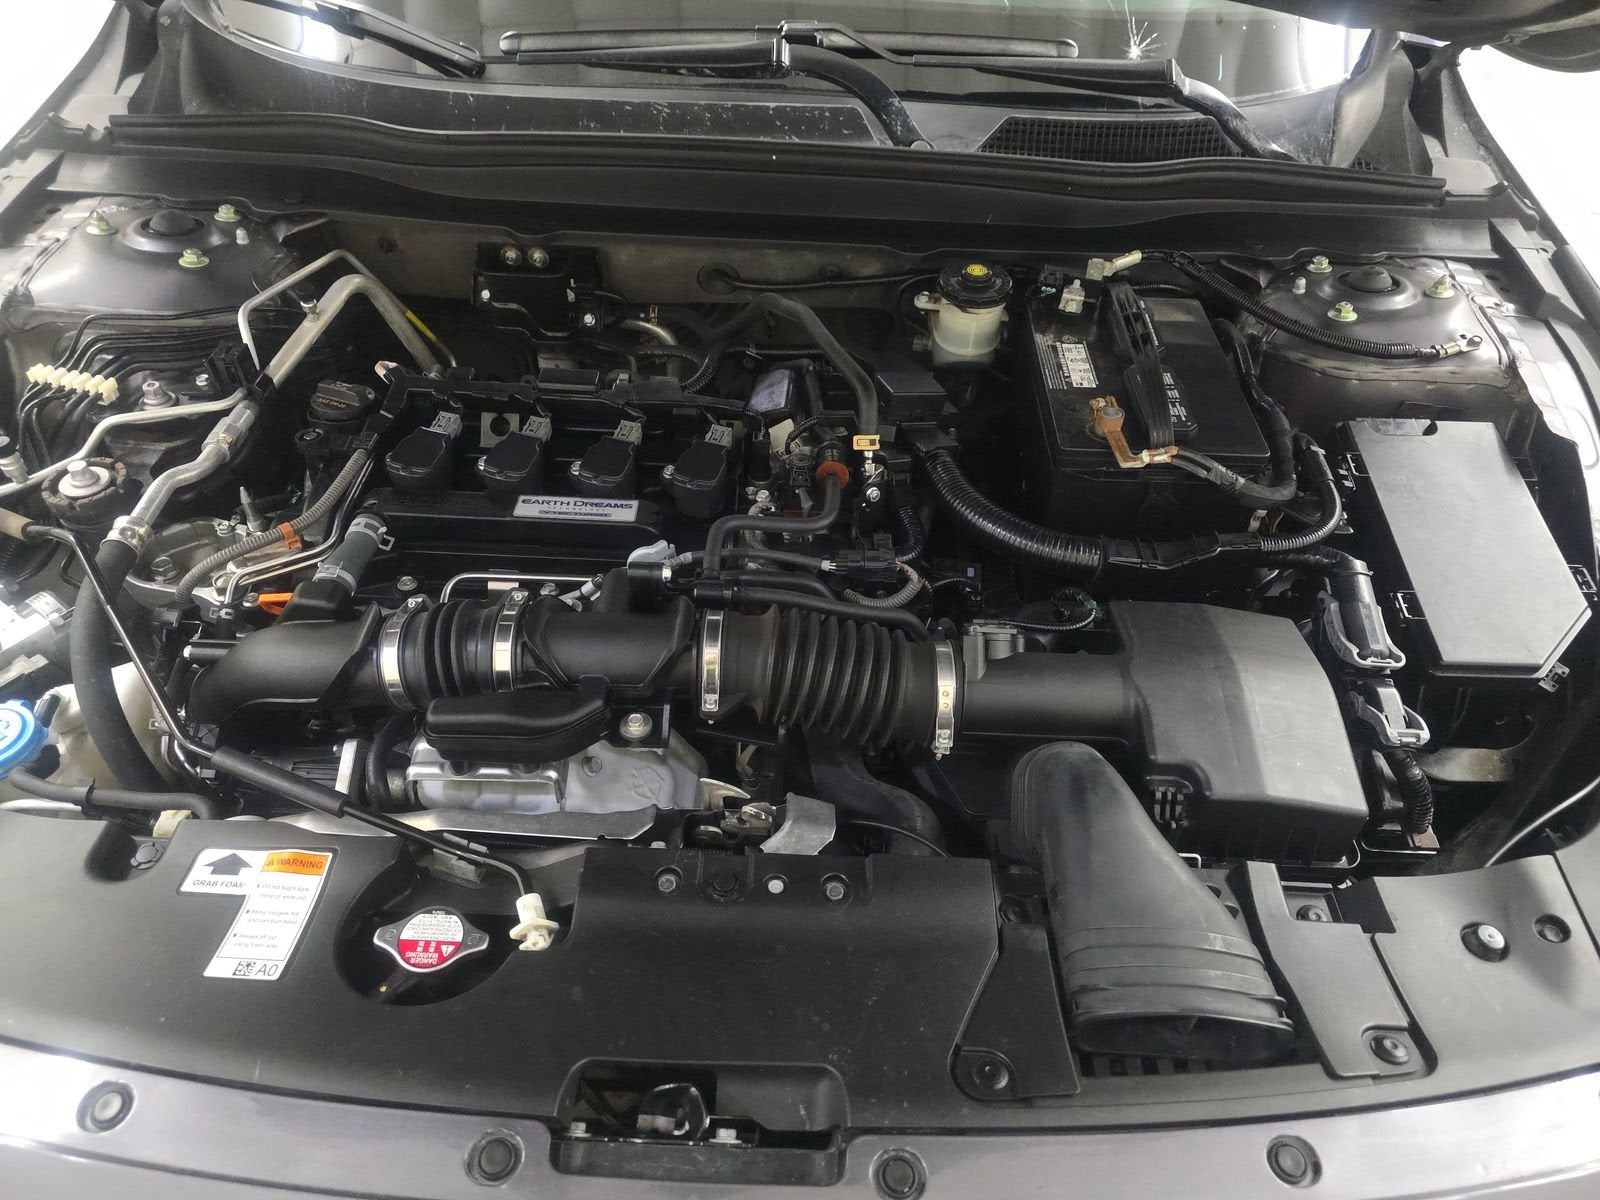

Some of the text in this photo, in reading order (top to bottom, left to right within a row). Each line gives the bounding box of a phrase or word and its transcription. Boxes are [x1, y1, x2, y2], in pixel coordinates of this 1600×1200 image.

[521, 498, 633, 509] EARTH DREAMS
[277, 856, 323, 869] WARNING
[192, 879, 219, 887] GRAB
